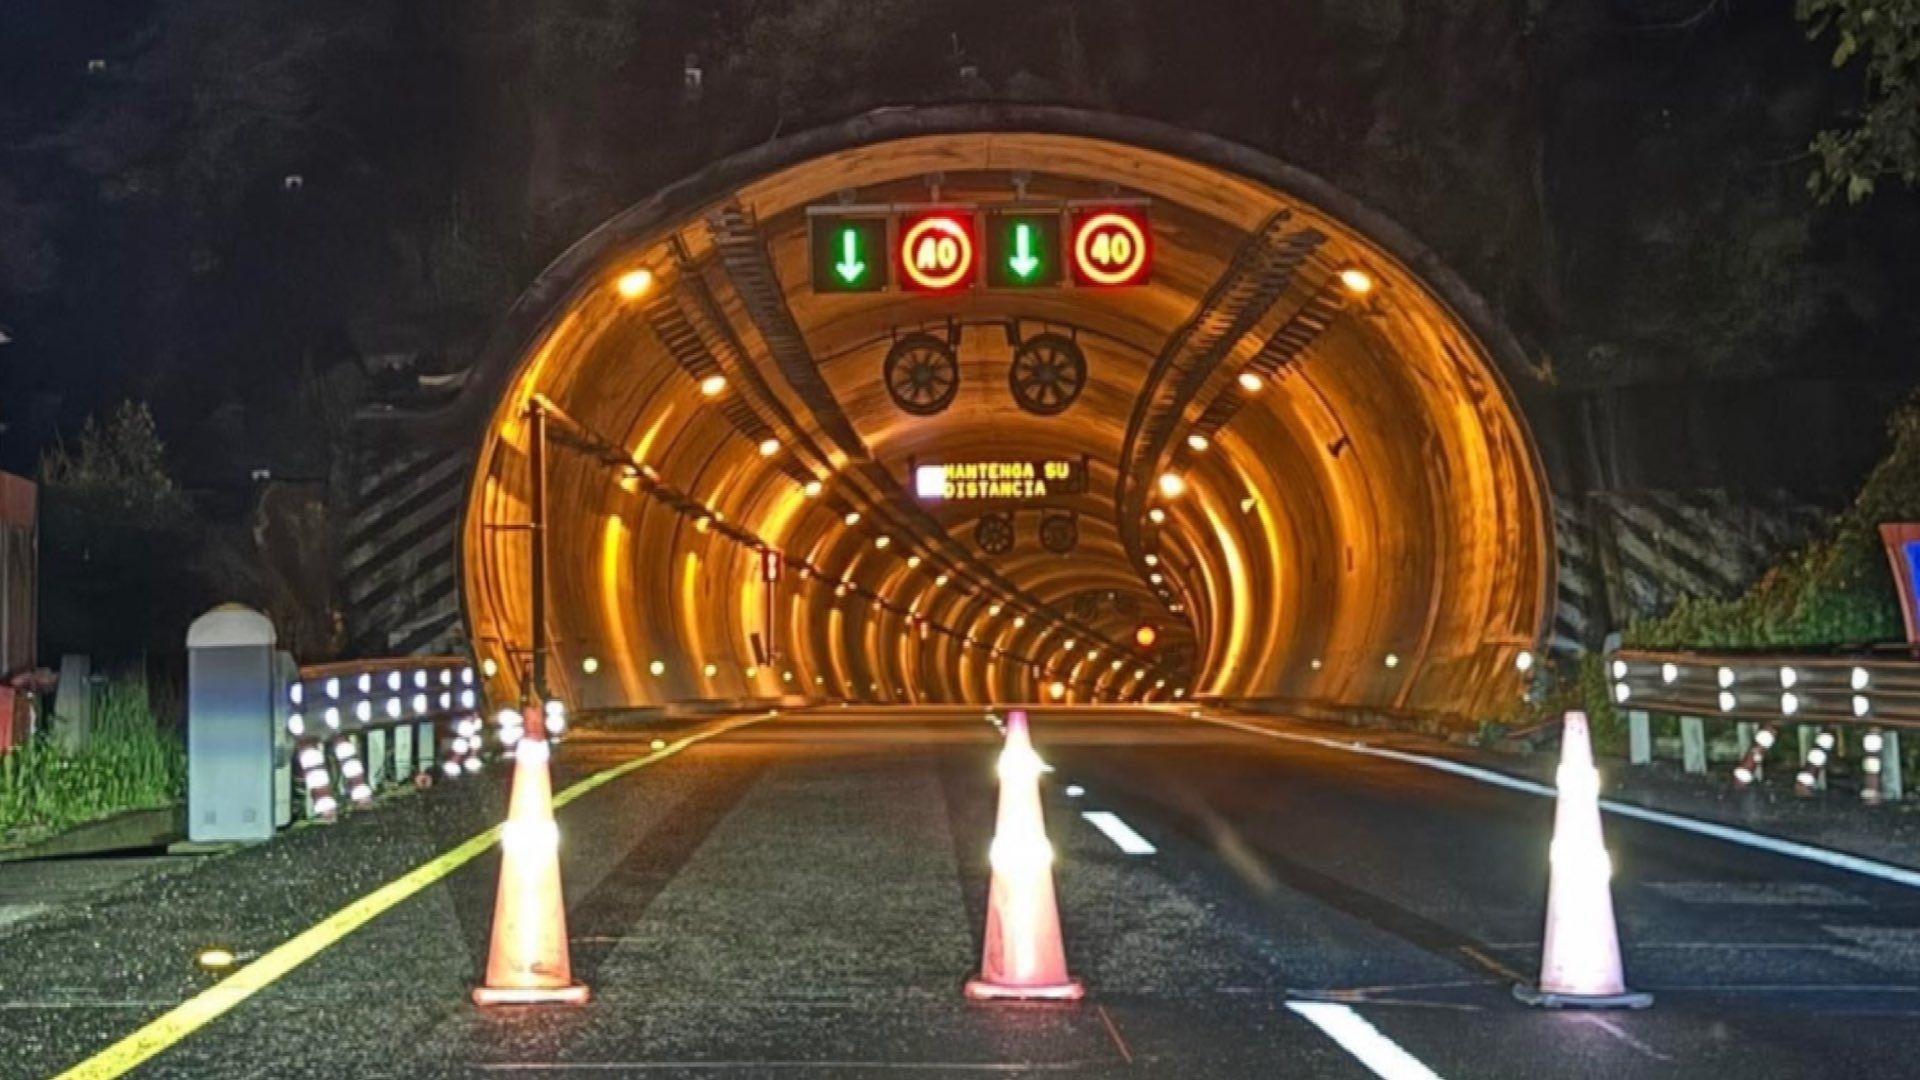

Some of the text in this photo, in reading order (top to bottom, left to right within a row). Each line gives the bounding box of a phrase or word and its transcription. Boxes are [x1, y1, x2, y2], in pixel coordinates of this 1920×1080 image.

[1091, 232, 1131, 266] 40
[944, 461, 1070, 479] MANTENGA SU
[943, 480, 1047, 498] DISTANCIA
